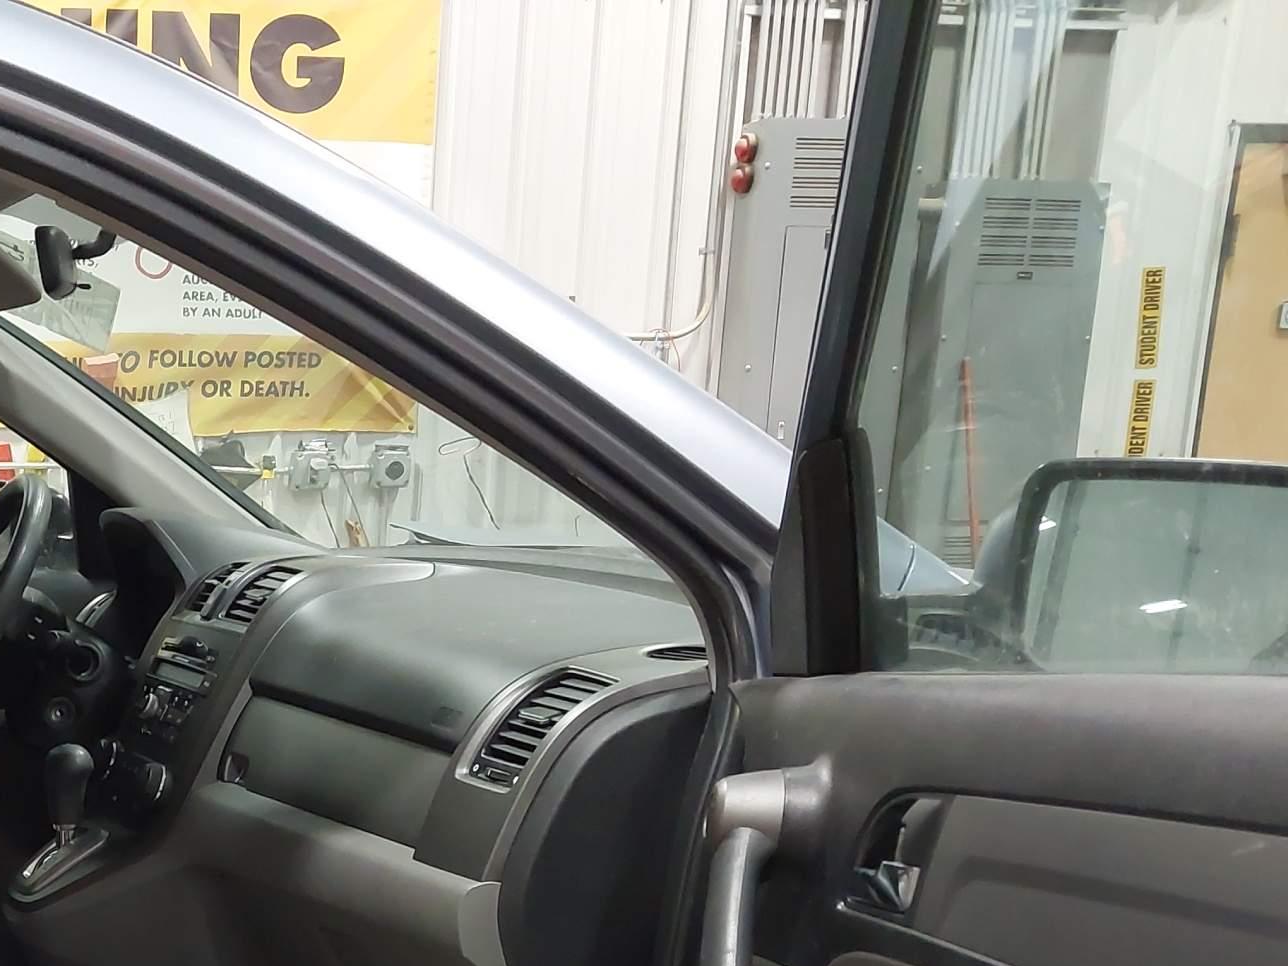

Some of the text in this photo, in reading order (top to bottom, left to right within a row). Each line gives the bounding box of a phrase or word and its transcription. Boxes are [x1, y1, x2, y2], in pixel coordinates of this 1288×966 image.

[183, 291, 218, 303] AREA,
[183, 307, 198, 317] BY
[202, 307, 221, 318] AN
[1139, 269, 1163, 366] STUDENT DRIVER
[117, 350, 322, 373] O FOLLOW POSTED
[201, 380, 232, 397] OR
[240, 380, 310, 397] DEATH.
[1133, 381, 1153, 422] DRIVER
